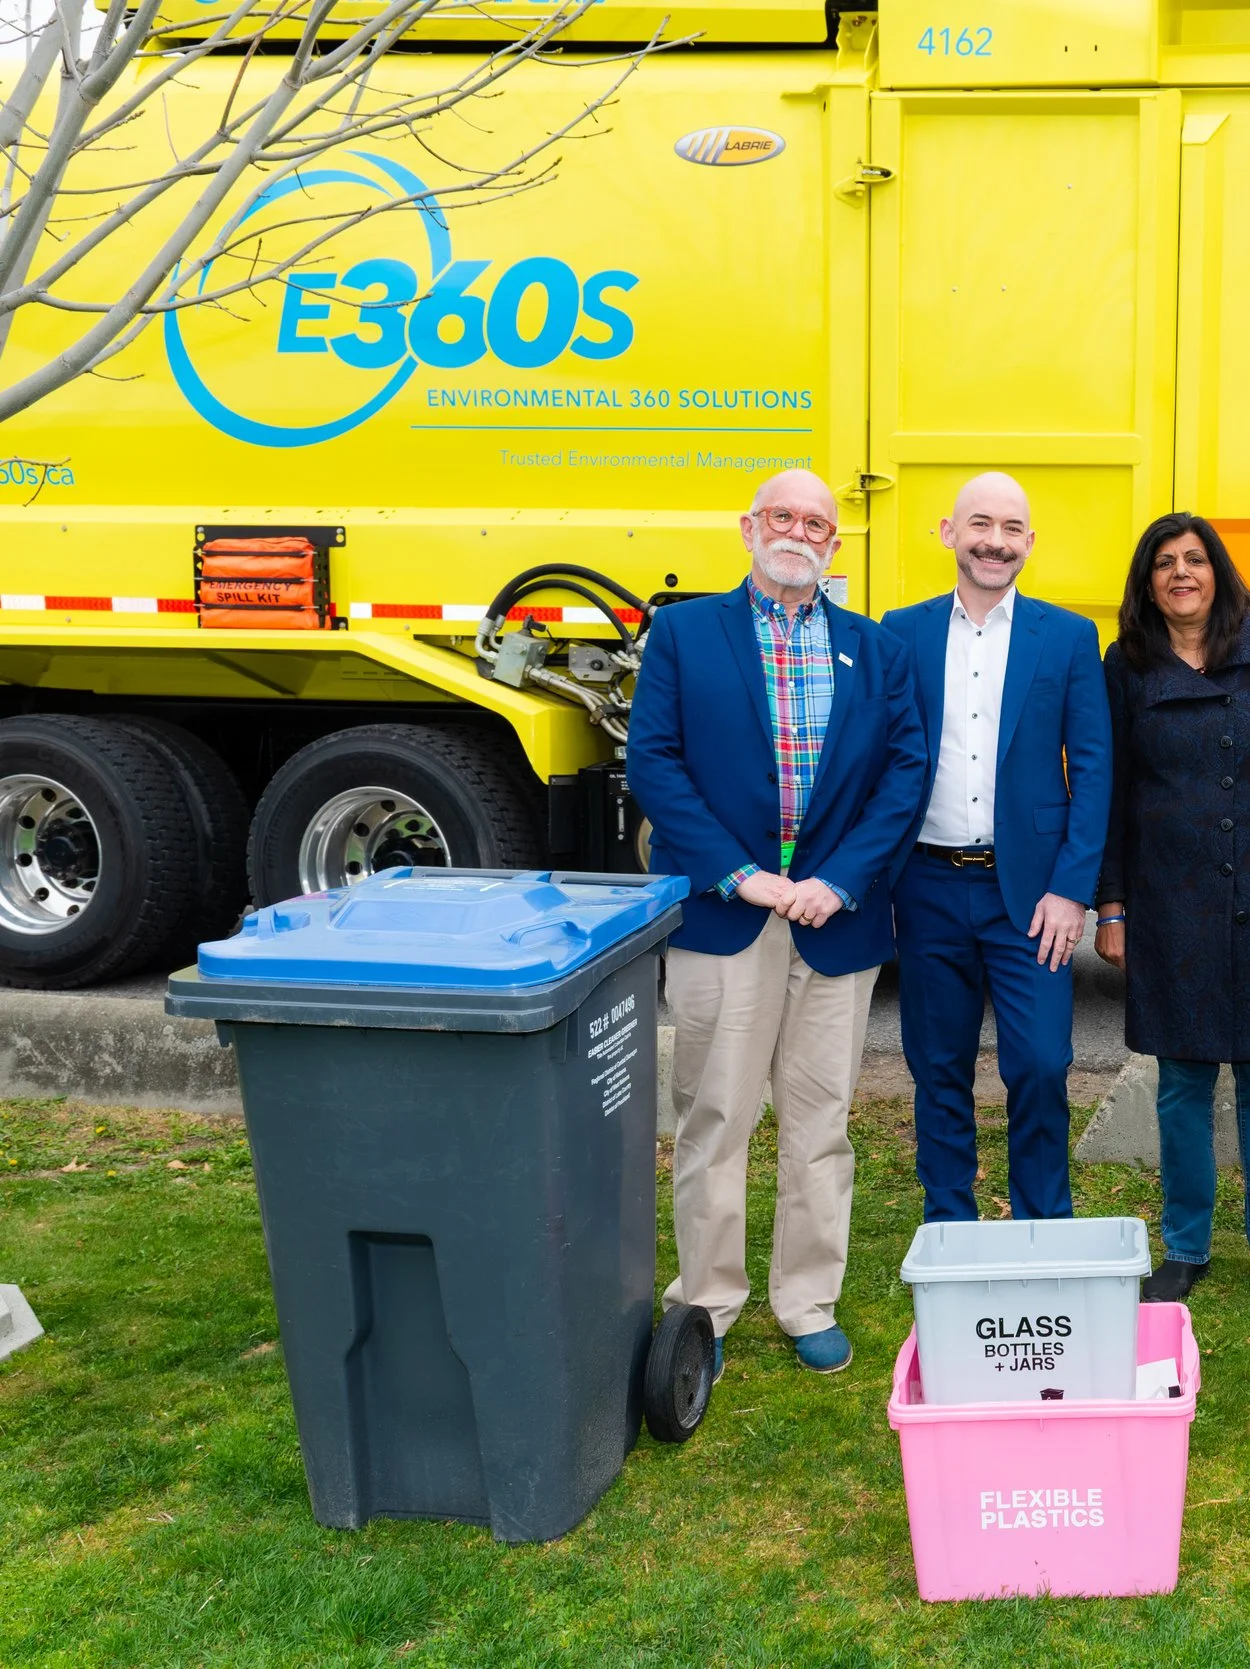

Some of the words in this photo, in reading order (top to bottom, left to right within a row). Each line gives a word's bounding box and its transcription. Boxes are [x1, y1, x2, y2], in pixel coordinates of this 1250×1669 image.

[918, 27, 992, 56] 4162
[724, 141, 773, 151] LABRIE
[276, 256, 641, 370] E360S
[426, 389, 623, 408] ENVIRONMENTAL
[630, 390, 670, 409] 360
[678, 390, 813, 409] SOLUTIONS
[0, 458, 75, 485] 0sca
[500, 449, 563, 467] Trusted
[568, 450, 691, 469] Environmental
[696, 451, 813, 473] Management
[209, 580, 293, 591] EMERGENCY
[216, 592, 254, 603] SPILL
[257, 593, 281, 603] KIT
[589, 1016, 603, 1040] 522
[975, 1315, 1073, 1340] GLASS
[984, 1342, 1065, 1357] BOTTLES
[994, 1361, 1005, 1372] +
[1009, 1357, 1056, 1372] JARS
[980, 1488, 1103, 1509] FLEXIBLE
[981, 1508, 1105, 1531] PLASTICS
